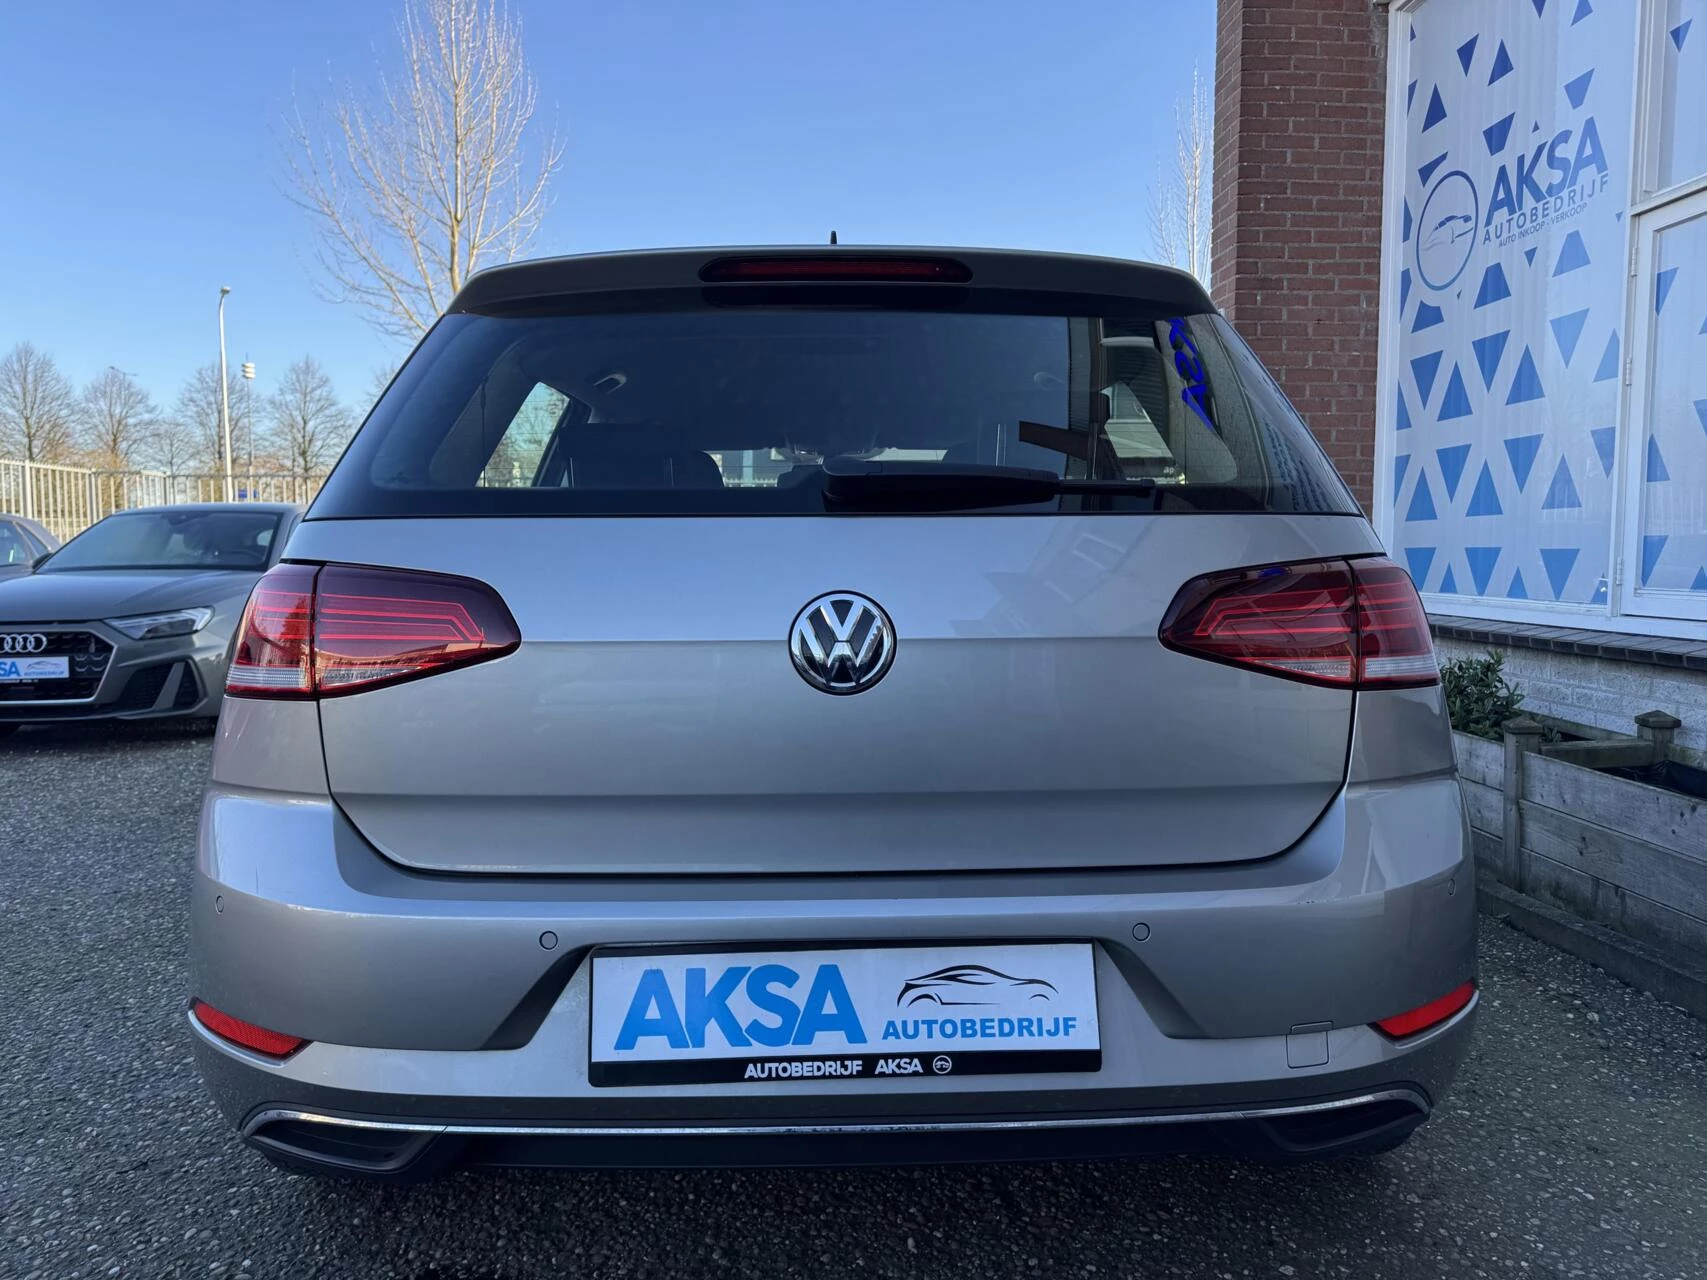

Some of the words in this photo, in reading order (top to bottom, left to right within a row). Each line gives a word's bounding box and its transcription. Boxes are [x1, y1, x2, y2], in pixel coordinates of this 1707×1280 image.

[1484, 117, 1609, 228] AKSA
[1483, 173, 1609, 245] AUTOBEDRIJF
[1498, 232, 1518, 248] AUTO
[1518, 221, 1546, 241] INKOOP
[1551, 202, 1588, 225] VERKOOP
[614, 964, 868, 1050] AKSA
[882, 1016, 1077, 1040] AUTOBEDRIJF
[744, 1059, 863, 1079] AUTOBEDRIJF
[874, 1058, 923, 1074] AKSA
